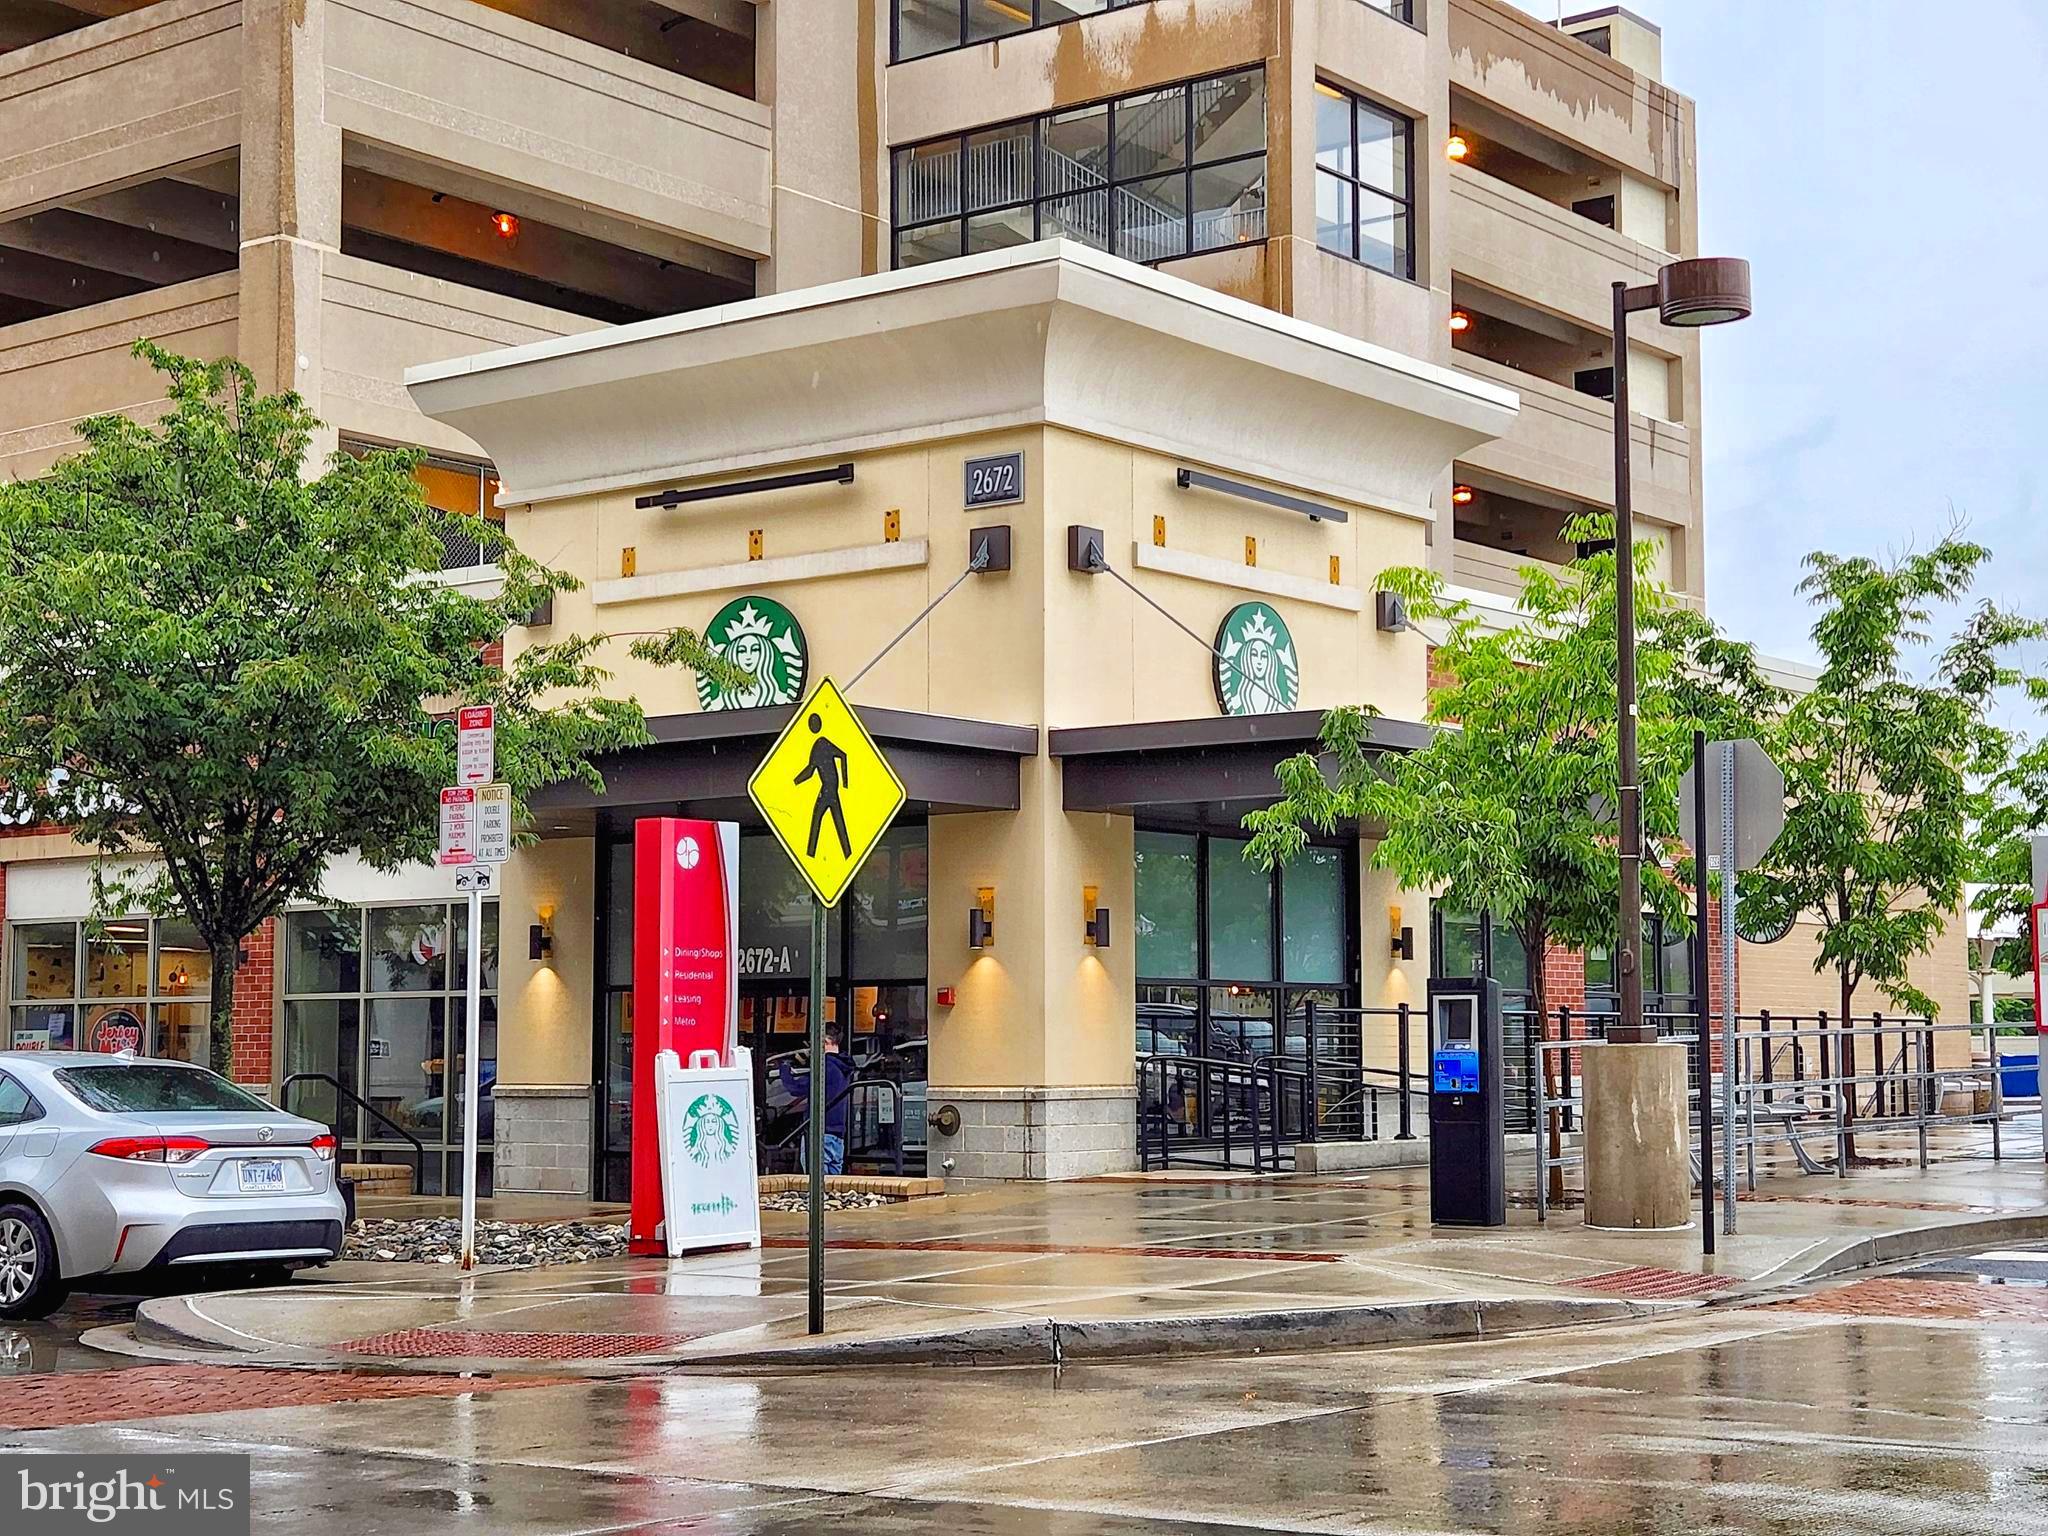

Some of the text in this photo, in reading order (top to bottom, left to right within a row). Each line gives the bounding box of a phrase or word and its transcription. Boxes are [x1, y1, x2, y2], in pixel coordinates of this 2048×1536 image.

[973, 465, 1013, 495] 2672
[464, 710, 488, 719] LOADING
[469, 719, 483, 727] ZONE
[482, 789, 503, 800] NOTICE
[484, 805, 500, 815] DOUBLE
[483, 819, 501, 829] PARKING
[485, 848, 493, 857] ALL
[494, 847, 506, 857] TIMES
[739, 946, 791, 974] 2672-A
[675, 970, 714, 980] Residential
[675, 995, 702, 1005] Leasing
[674, 1016, 696, 1026] Metro
[97, 1020, 139, 1046] Jersey
[242, 1169, 283, 1183] UNT-7460
